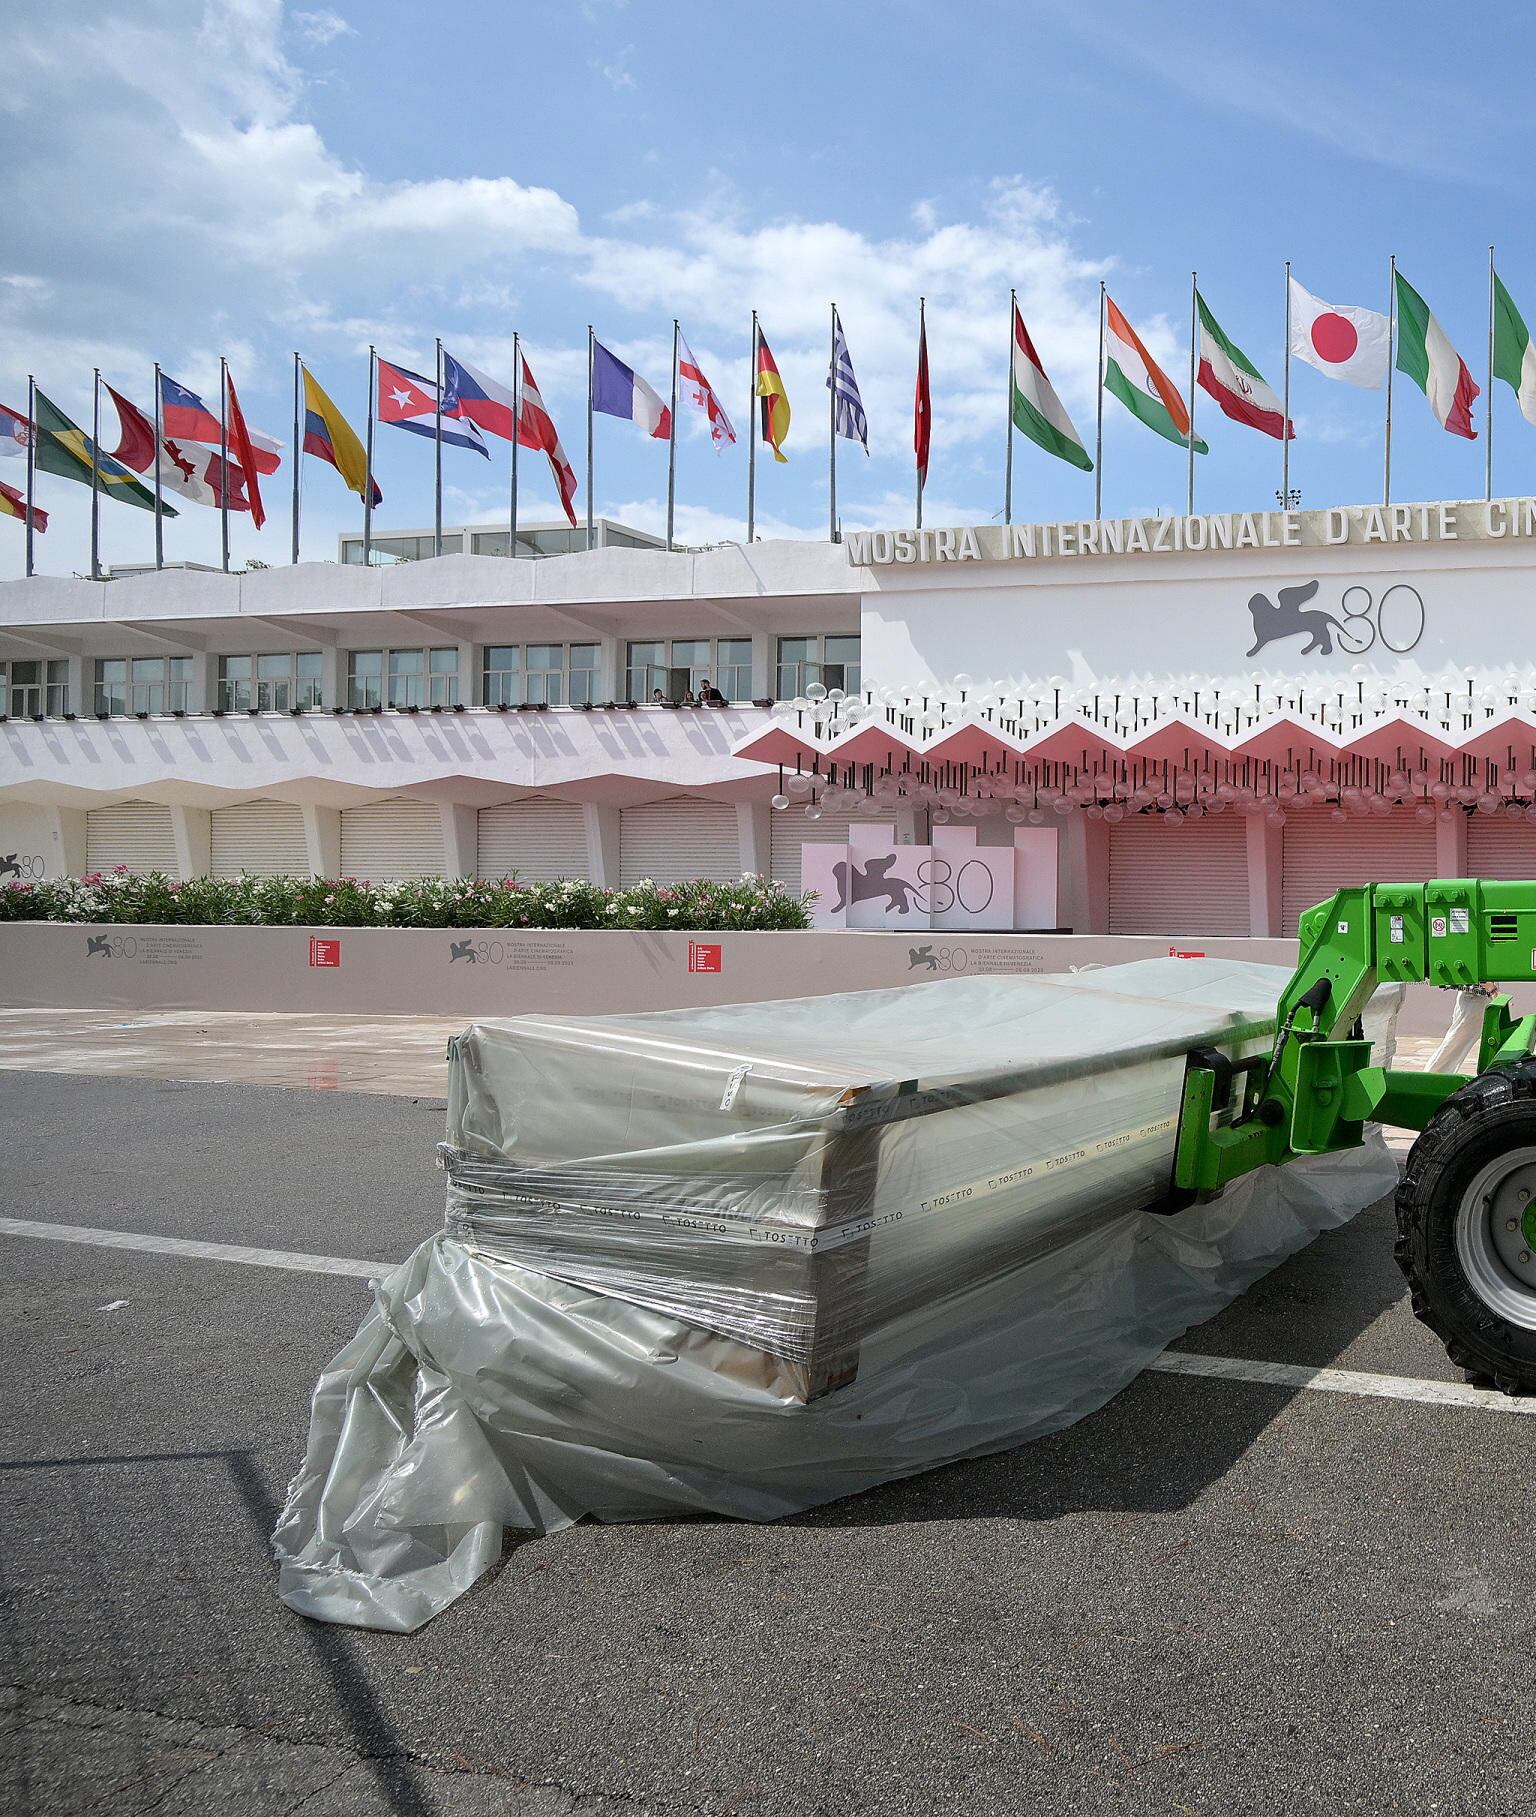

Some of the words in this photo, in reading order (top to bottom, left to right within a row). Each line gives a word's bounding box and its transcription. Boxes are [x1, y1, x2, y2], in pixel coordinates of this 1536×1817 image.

[844, 527, 982, 567] MOSTRA
[1002, 510, 1301, 560] INTERNAZIONALE
[1326, 503, 1458, 545] D'ARTE
[1337, 585, 1425, 654] 80
[913, 859, 994, 914] 80
[938, 947, 968, 971] 80
[1054, 1150, 1086, 1166] TOSETTO
[998, 1167, 1034, 1186] TOSETTO
[932, 1187, 973, 1208] TOSETTO
[764, 1231, 819, 1248] TOSETTO
